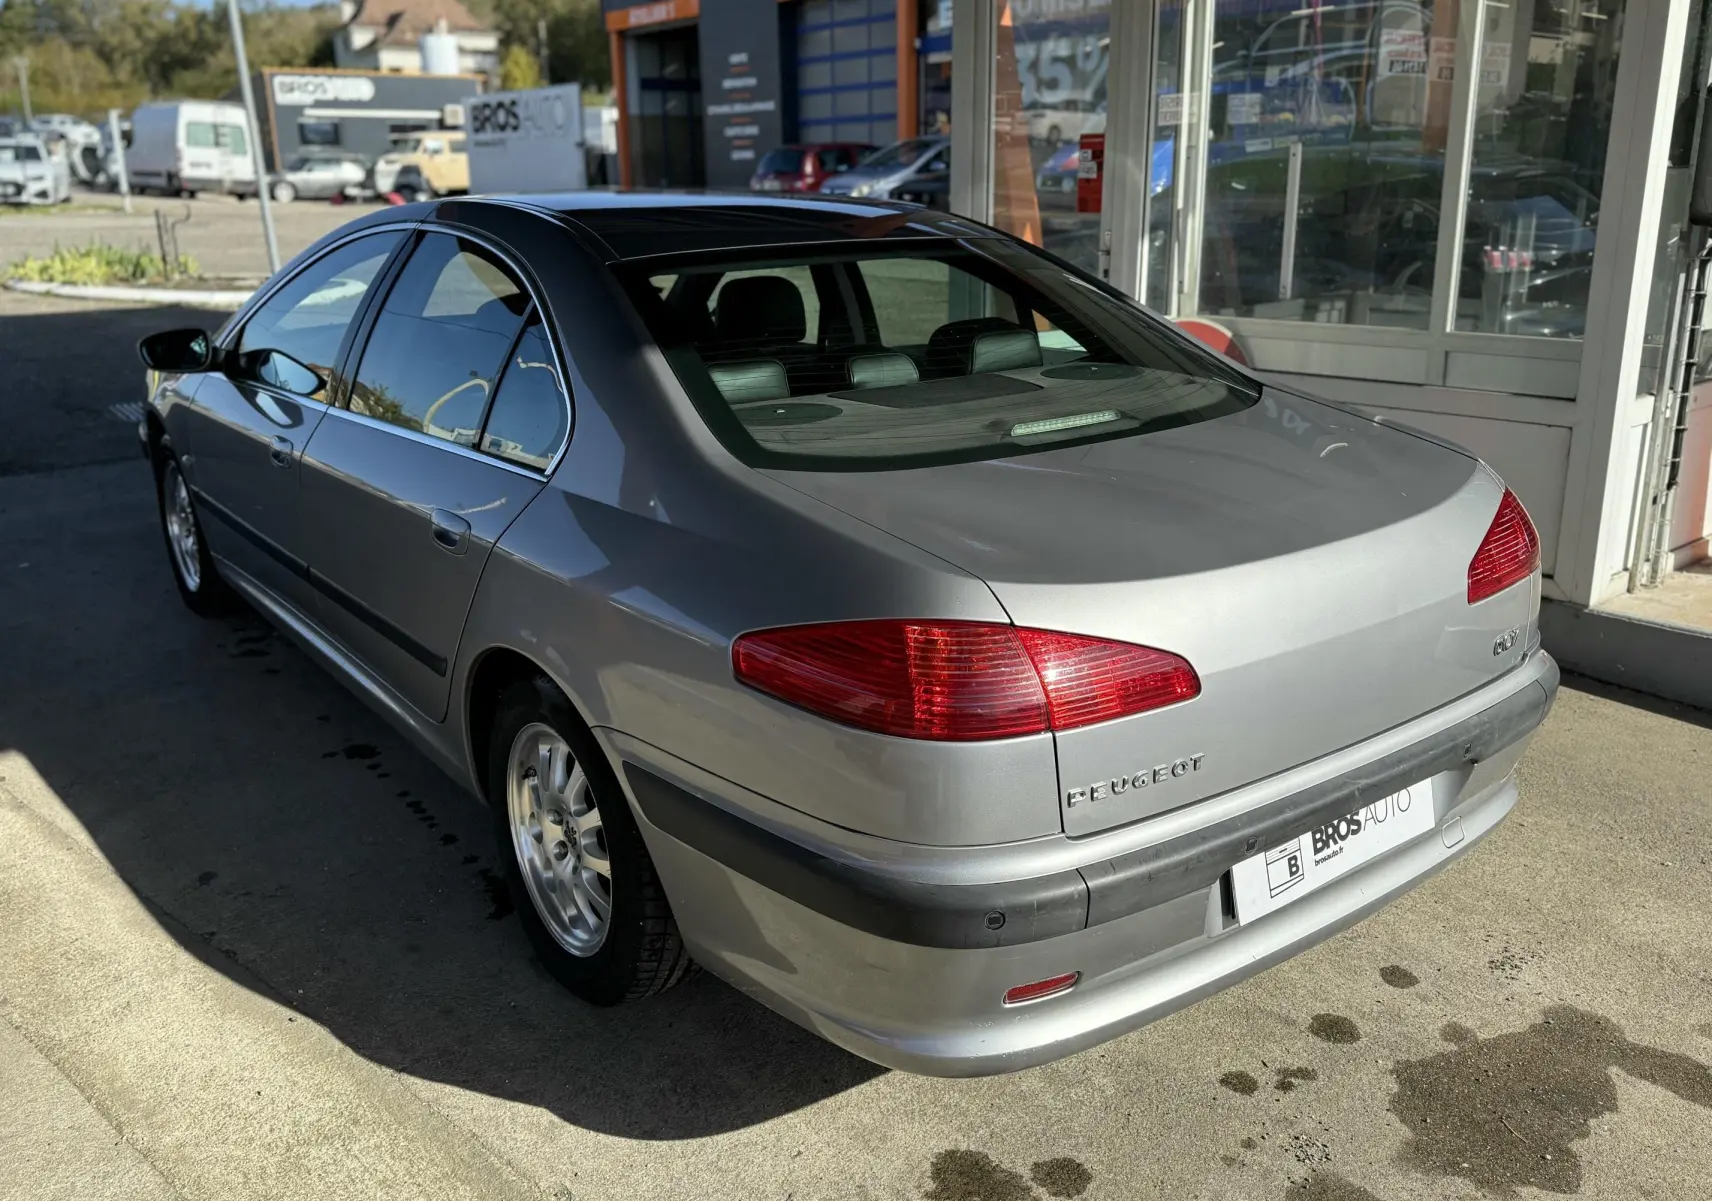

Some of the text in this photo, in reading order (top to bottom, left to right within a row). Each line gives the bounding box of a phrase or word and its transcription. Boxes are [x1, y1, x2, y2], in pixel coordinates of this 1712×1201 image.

[1067, 752, 1205, 809] PEUGEOT
[1287, 854, 1300, 878] B
[1314, 845, 1344, 867] brosauto.fr
